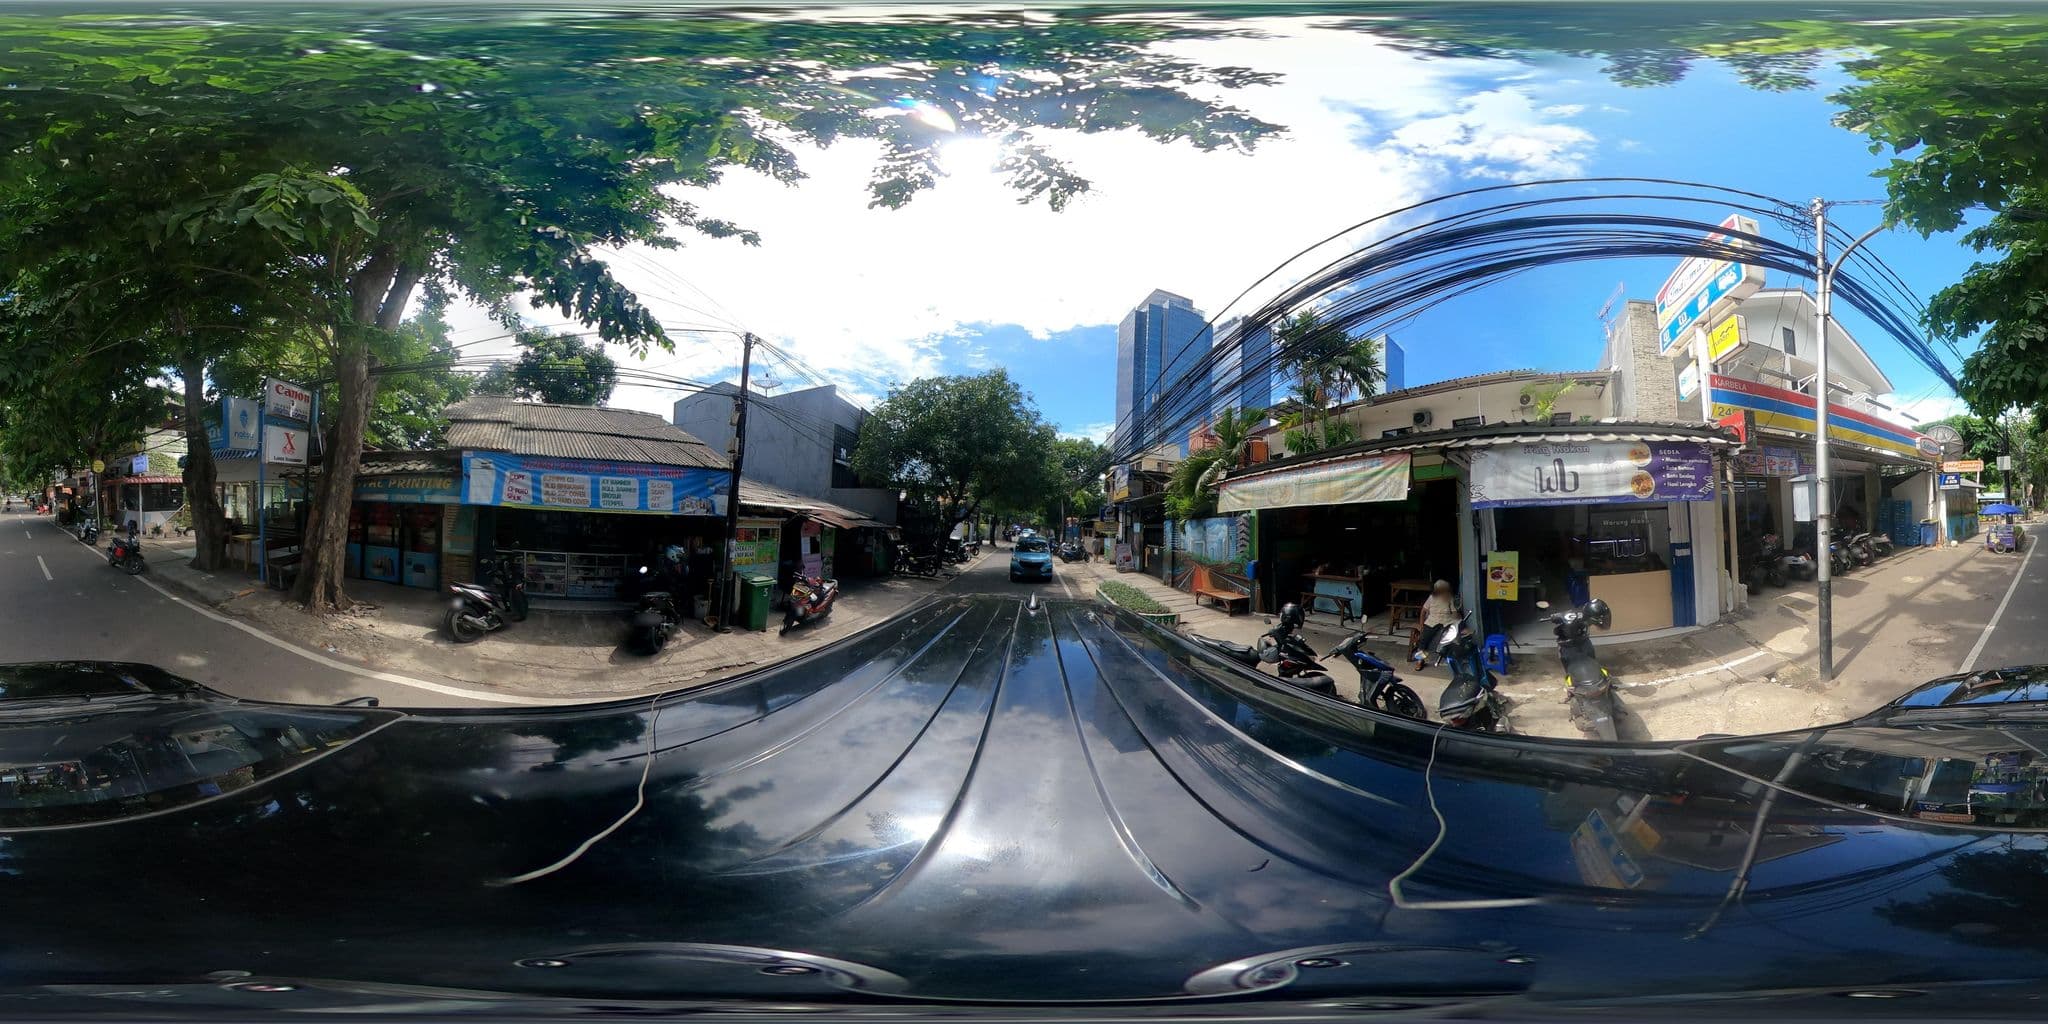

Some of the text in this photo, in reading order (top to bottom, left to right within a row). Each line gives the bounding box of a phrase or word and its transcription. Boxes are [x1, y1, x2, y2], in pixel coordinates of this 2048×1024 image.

[1713, 377, 1747, 391] KARBELA
[275, 384, 310, 404] Canon
[388, 479, 452, 488] PRINTING
